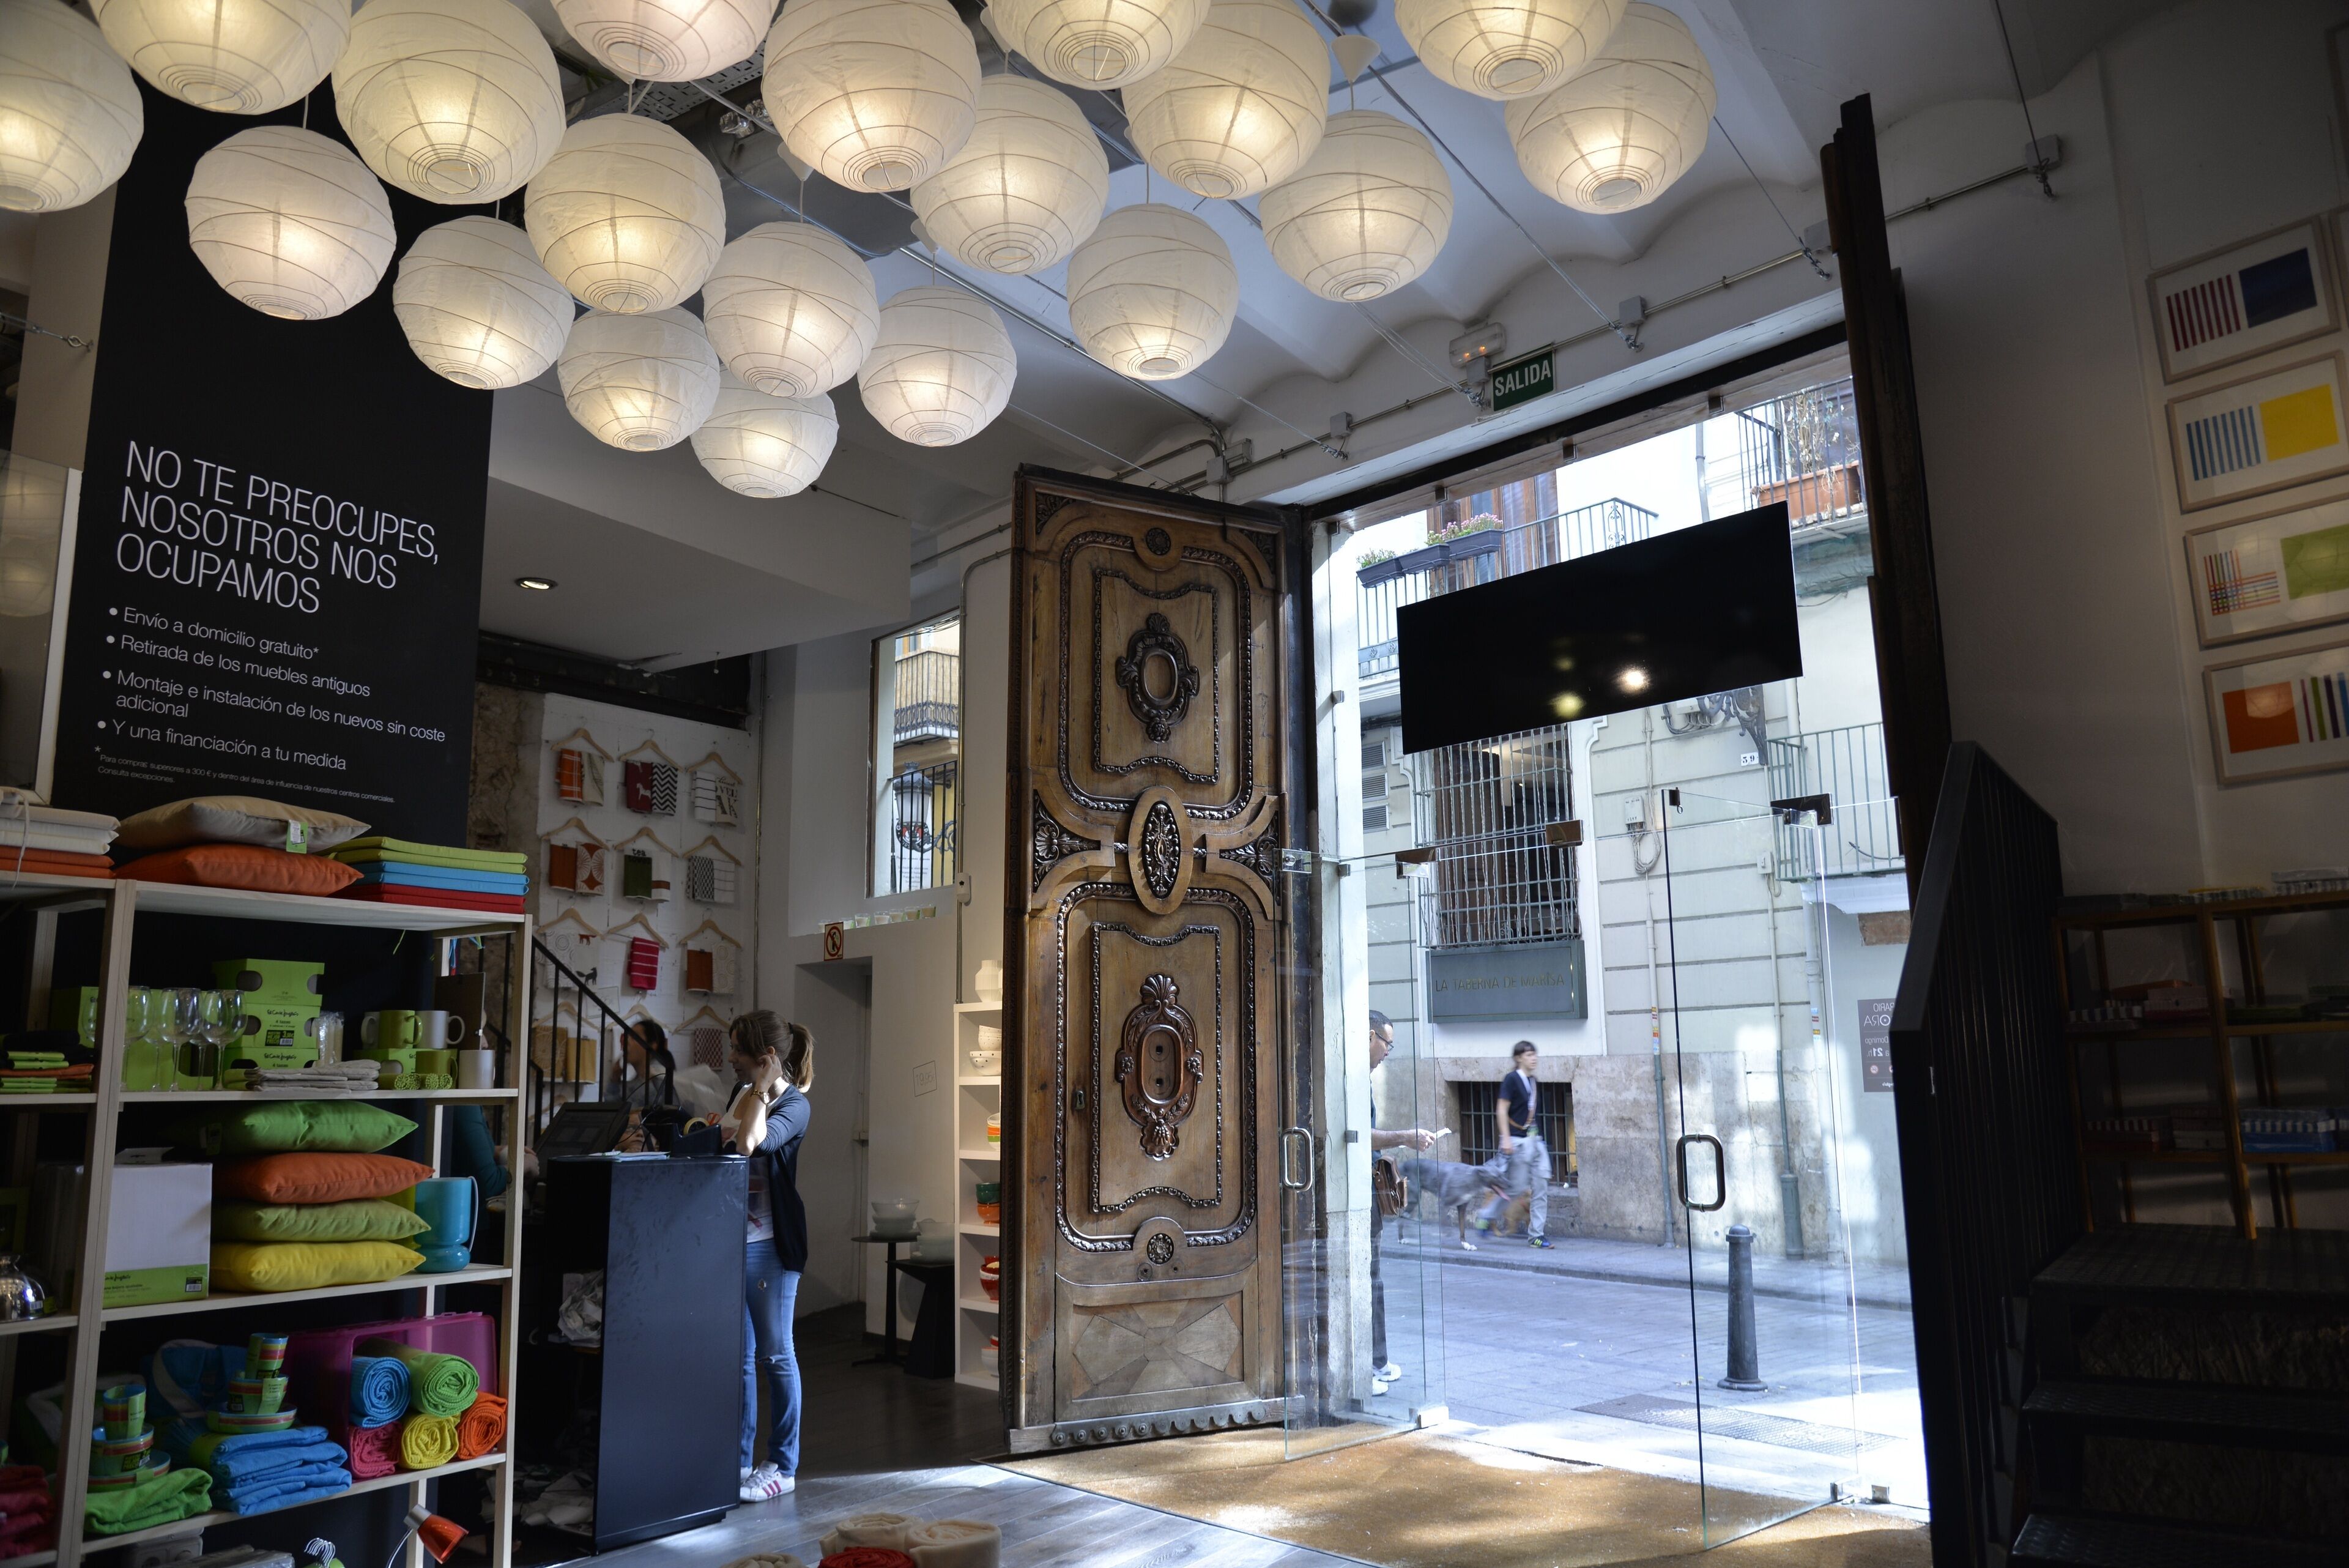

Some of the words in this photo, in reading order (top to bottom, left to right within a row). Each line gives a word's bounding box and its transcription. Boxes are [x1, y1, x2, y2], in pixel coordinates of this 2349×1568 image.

[1494, 360, 1551, 396] SALIDA
[127, 440, 181, 488] NO
[193, 459, 236, 505] TE
[247, 475, 438, 564] PREOCUPES,
[122, 486, 319, 569] NOSOTROS
[331, 541, 396, 589] NOS
[117, 533, 320, 613] OCUPAMOS
[124, 607, 168, 629] Envío
[173, 622, 183, 633] a
[188, 622, 254, 647] domicilio
[122, 635, 188, 661] Retirada
[193, 651, 213, 666] de
[219, 655, 240, 671] los
[245, 663, 307, 684] muebles
[312, 677, 369, 696] antiguos
[116, 695, 188, 717] adicional
[118, 670, 183, 696] Montaje
[188, 687, 198, 697] e
[204, 686, 281, 712] instalación
[287, 702, 305, 717] de
[310, 705, 329, 721] los
[334, 713, 383, 730] nuevos
[387, 721, 406, 734] sin
[410, 727, 445, 741] coste
[113, 719, 125, 734] Y
[130, 726, 160, 741] una
[166, 729, 256, 756] financiación
[262, 748, 270, 758] a
[276, 747, 289, 760] tu
[294, 752, 346, 770] medida
[98, 766, 129, 777] Consulta
[130, 771, 176, 783] excepciones.
[118, 759, 148, 768] compras
[191, 768, 205, 776] 300
[218, 772, 239, 781] dentro
[275, 780, 303, 790] influencia
[313, 786, 338, 795] nuestros
[339, 790, 360, 798] centros
[1436, 980, 1448, 992] LA
[1454, 978, 1499, 991] TABERNA
[1504, 976, 1518, 989] DE
